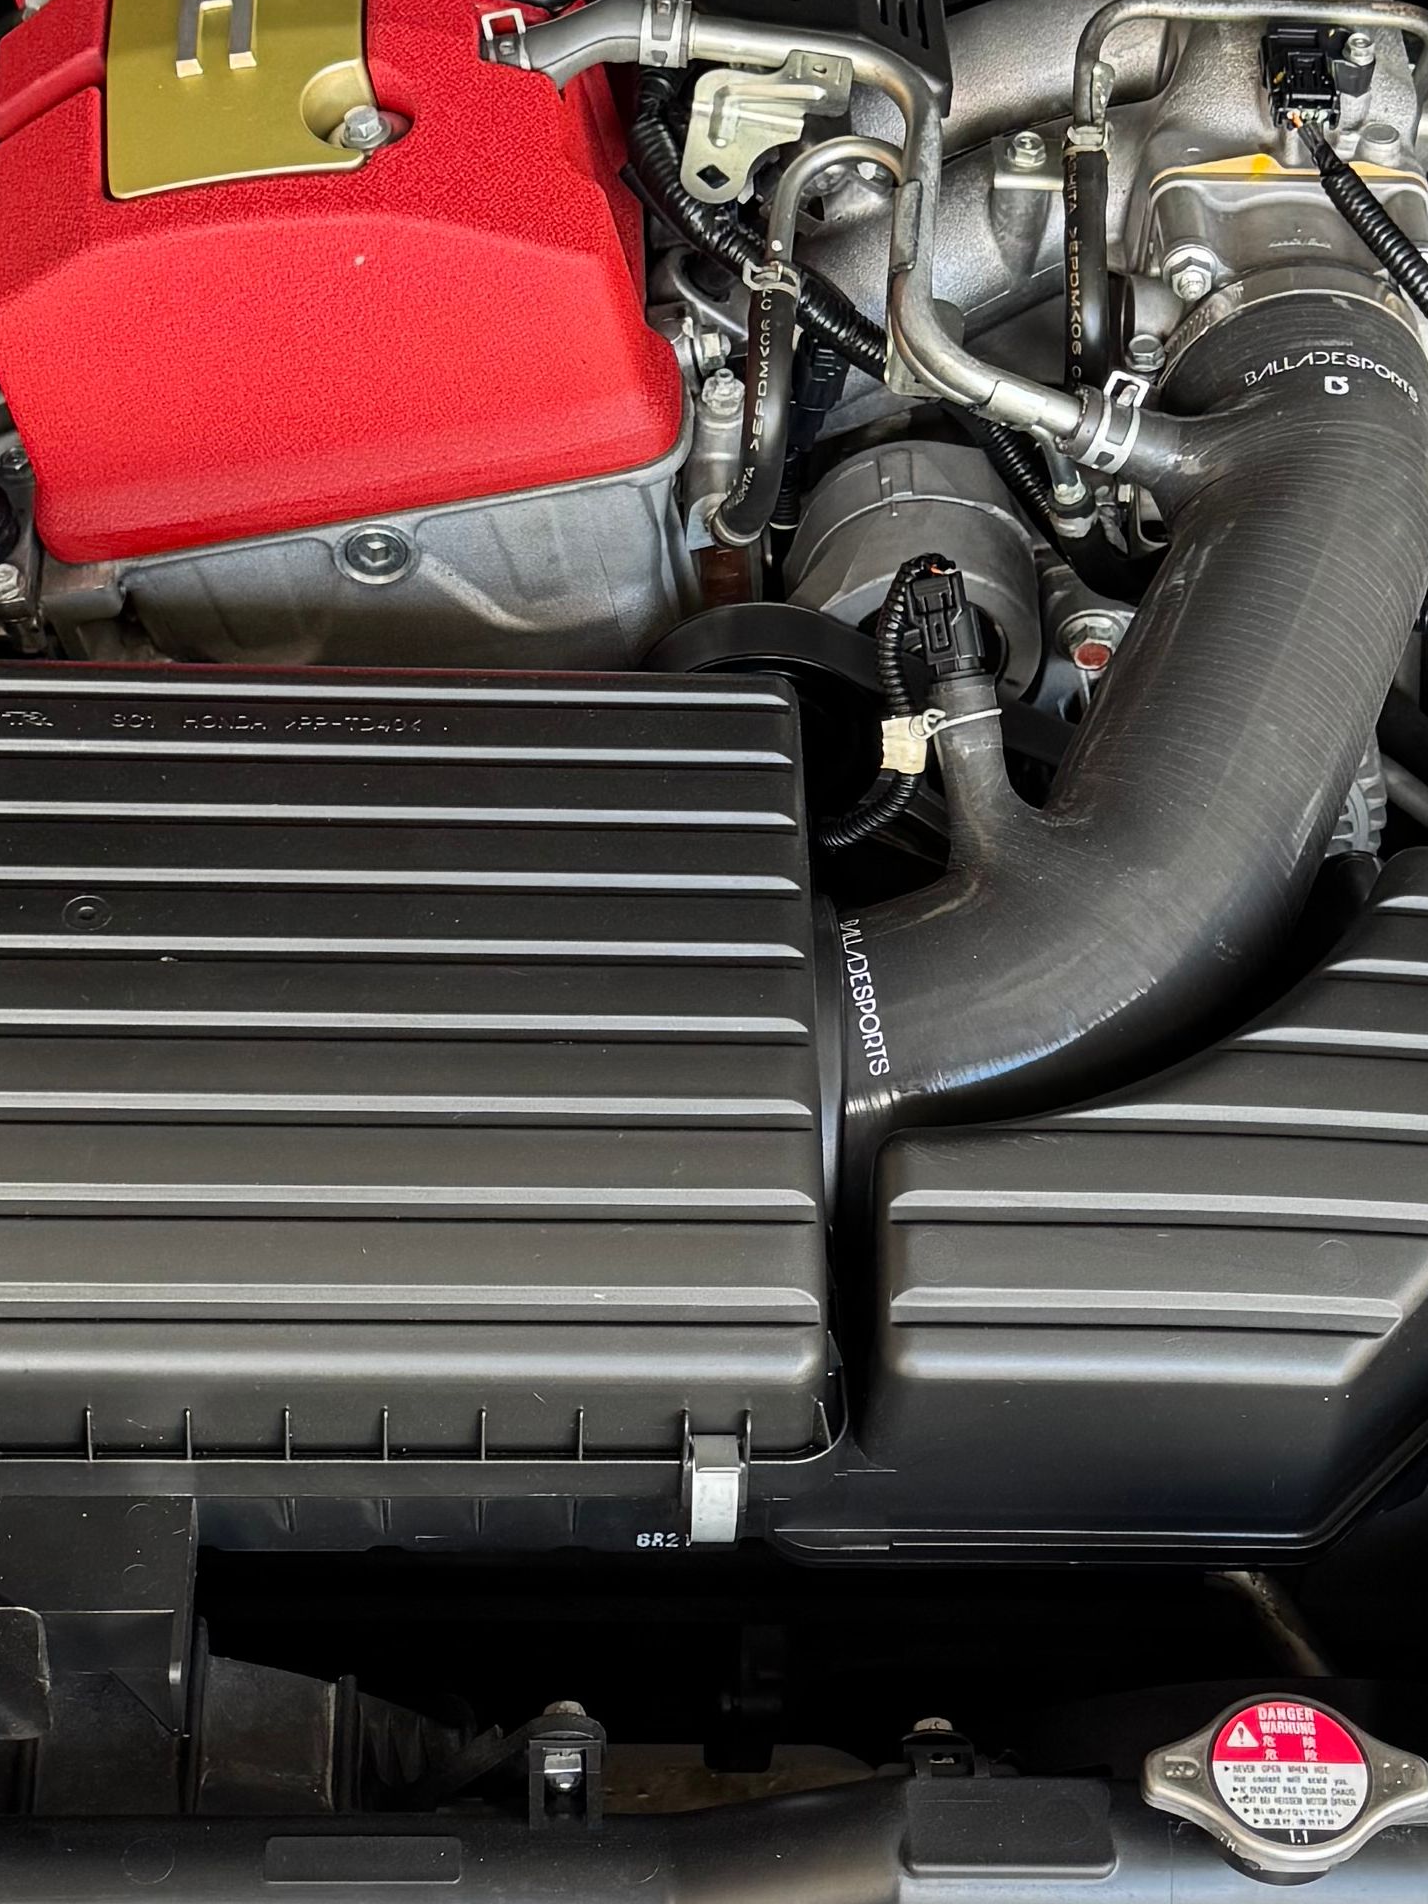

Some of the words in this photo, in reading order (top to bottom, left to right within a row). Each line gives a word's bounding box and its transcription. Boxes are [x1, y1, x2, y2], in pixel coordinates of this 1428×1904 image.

[1244, 351, 1420, 404] BALLADESPORTS
[1258, 1707, 1315, 1721] DANGER
[1289, 1829, 1309, 1844] 1.1
